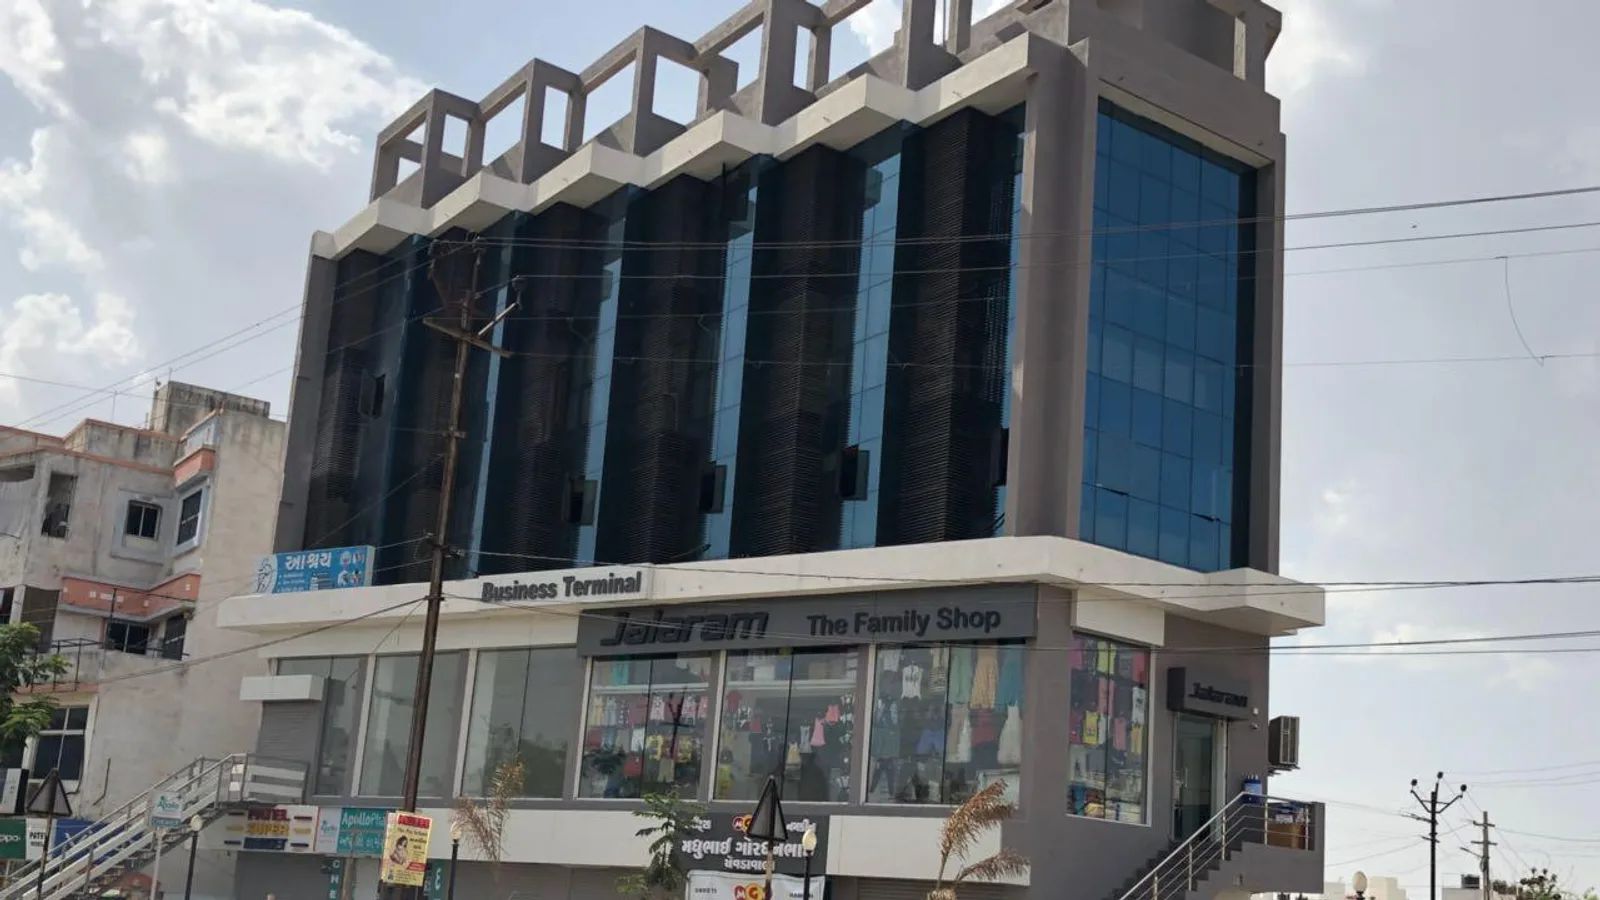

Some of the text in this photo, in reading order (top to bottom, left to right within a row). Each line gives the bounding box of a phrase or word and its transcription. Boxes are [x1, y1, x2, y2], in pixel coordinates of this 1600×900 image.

[285, 552, 332, 570] આશ્રય
[482, 571, 642, 601] Business Terminal
[600, 609, 769, 647] Jalaram
[807, 607, 1001, 637] The Family Shop
[30, 831, 47, 840] PATE
[681, 837, 732, 860] મધુભાઈ
